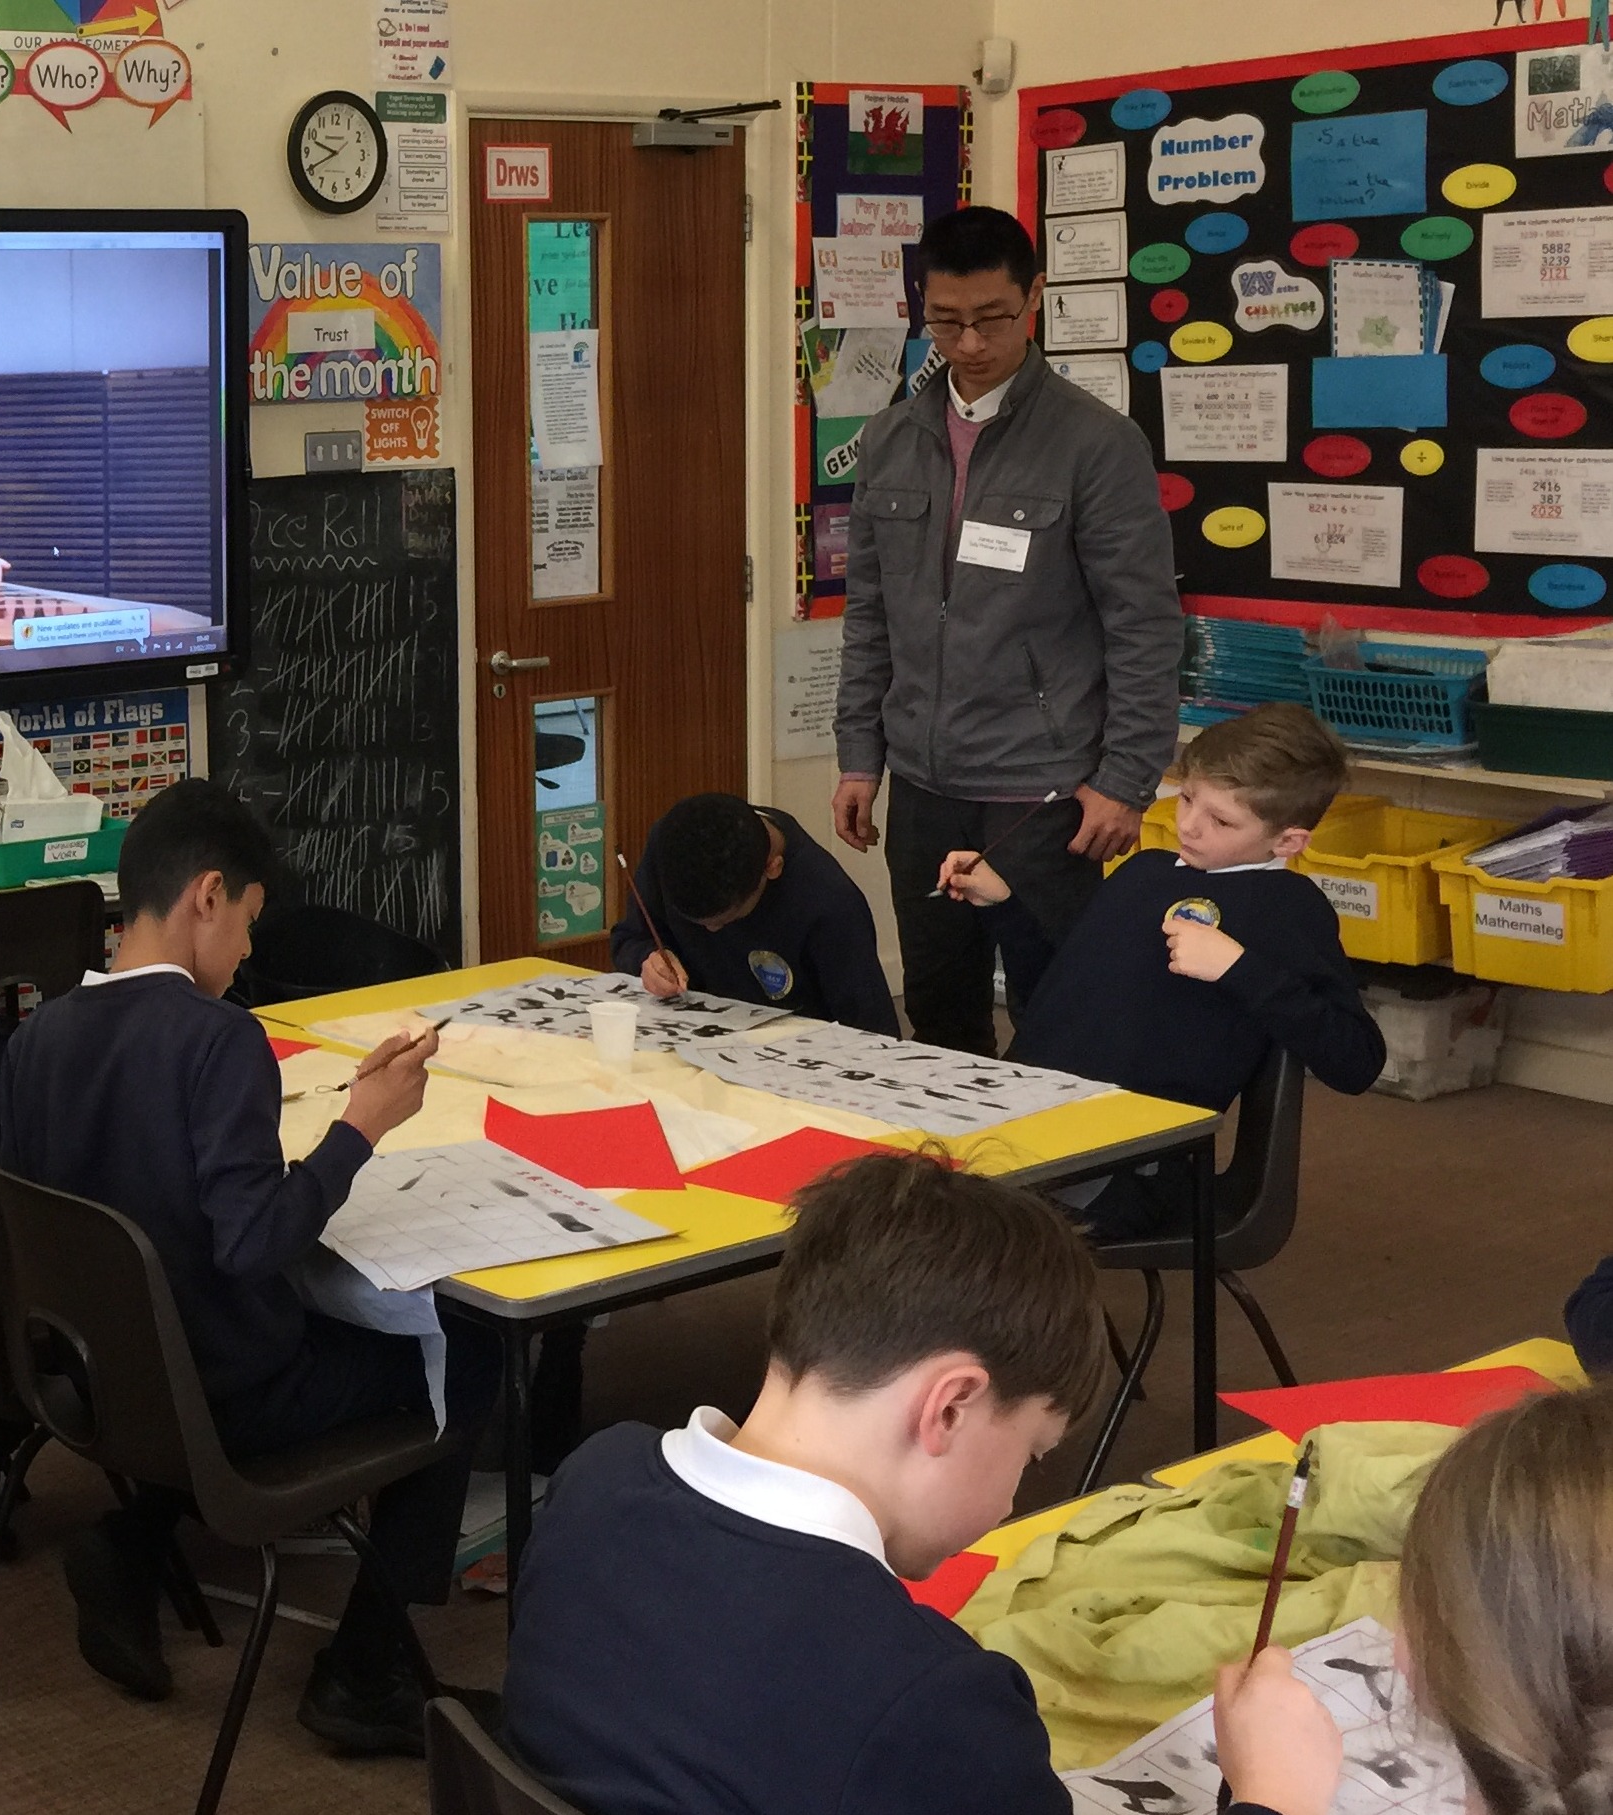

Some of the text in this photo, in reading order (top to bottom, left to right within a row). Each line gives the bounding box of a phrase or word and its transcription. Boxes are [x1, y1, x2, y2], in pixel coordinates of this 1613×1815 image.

[14, 36, 41, 49] OUR
[37, 64, 99, 89] Who?
[124, 60, 181, 92] Why?
[318, 116, 325, 129] 11
[331, 113, 340, 125] 12
[347, 118, 351, 130] 1
[307, 128, 317, 140] 10
[355, 131, 361, 144] 2
[1160, 134, 1253, 157] Number
[304, 147, 310, 159] 9
[360, 149, 366, 162] 3
[355, 166, 361, 178] 4
[496, 158, 539, 187] Drws
[318, 176, 324, 189] 7
[331, 181, 337, 194] 6
[344, 178, 350, 190] 5
[1157, 170, 1256, 192] Problem
[1466, 181, 1489, 189] Divide
[1541, 242, 1571, 254] 5882
[1541, 255, 1571, 267] 3239
[249, 245, 418, 302] Value of
[1540, 268, 1569, 280] 9121
[314, 328, 349, 342] Trust
[250, 347, 436, 400] the month
[371, 408, 409, 419] SWITCH
[381, 423, 400, 434] OFF
[374, 437, 407, 448] LIGHTS
[1532, 481, 1562, 492] 2416
[1539, 494, 1562, 504] 387
[1309, 504, 1348, 514] 824 6
[1531, 505, 1563, 517] 2029
[323, 493, 380, 550] Roll
[1314, 534, 1320, 544] 6
[54, 623, 80, 632] updates
[94, 618, 122, 628] available
[74, 705, 95, 727] of
[103, 700, 164, 726] Flags
[52, 850, 77, 861] WORK
[1320, 878, 1368, 897] English
[1330, 899, 1371, 917] esneg
[1498, 898, 1542, 917] Maths
[1475, 914, 1564, 938] Mathemateg
